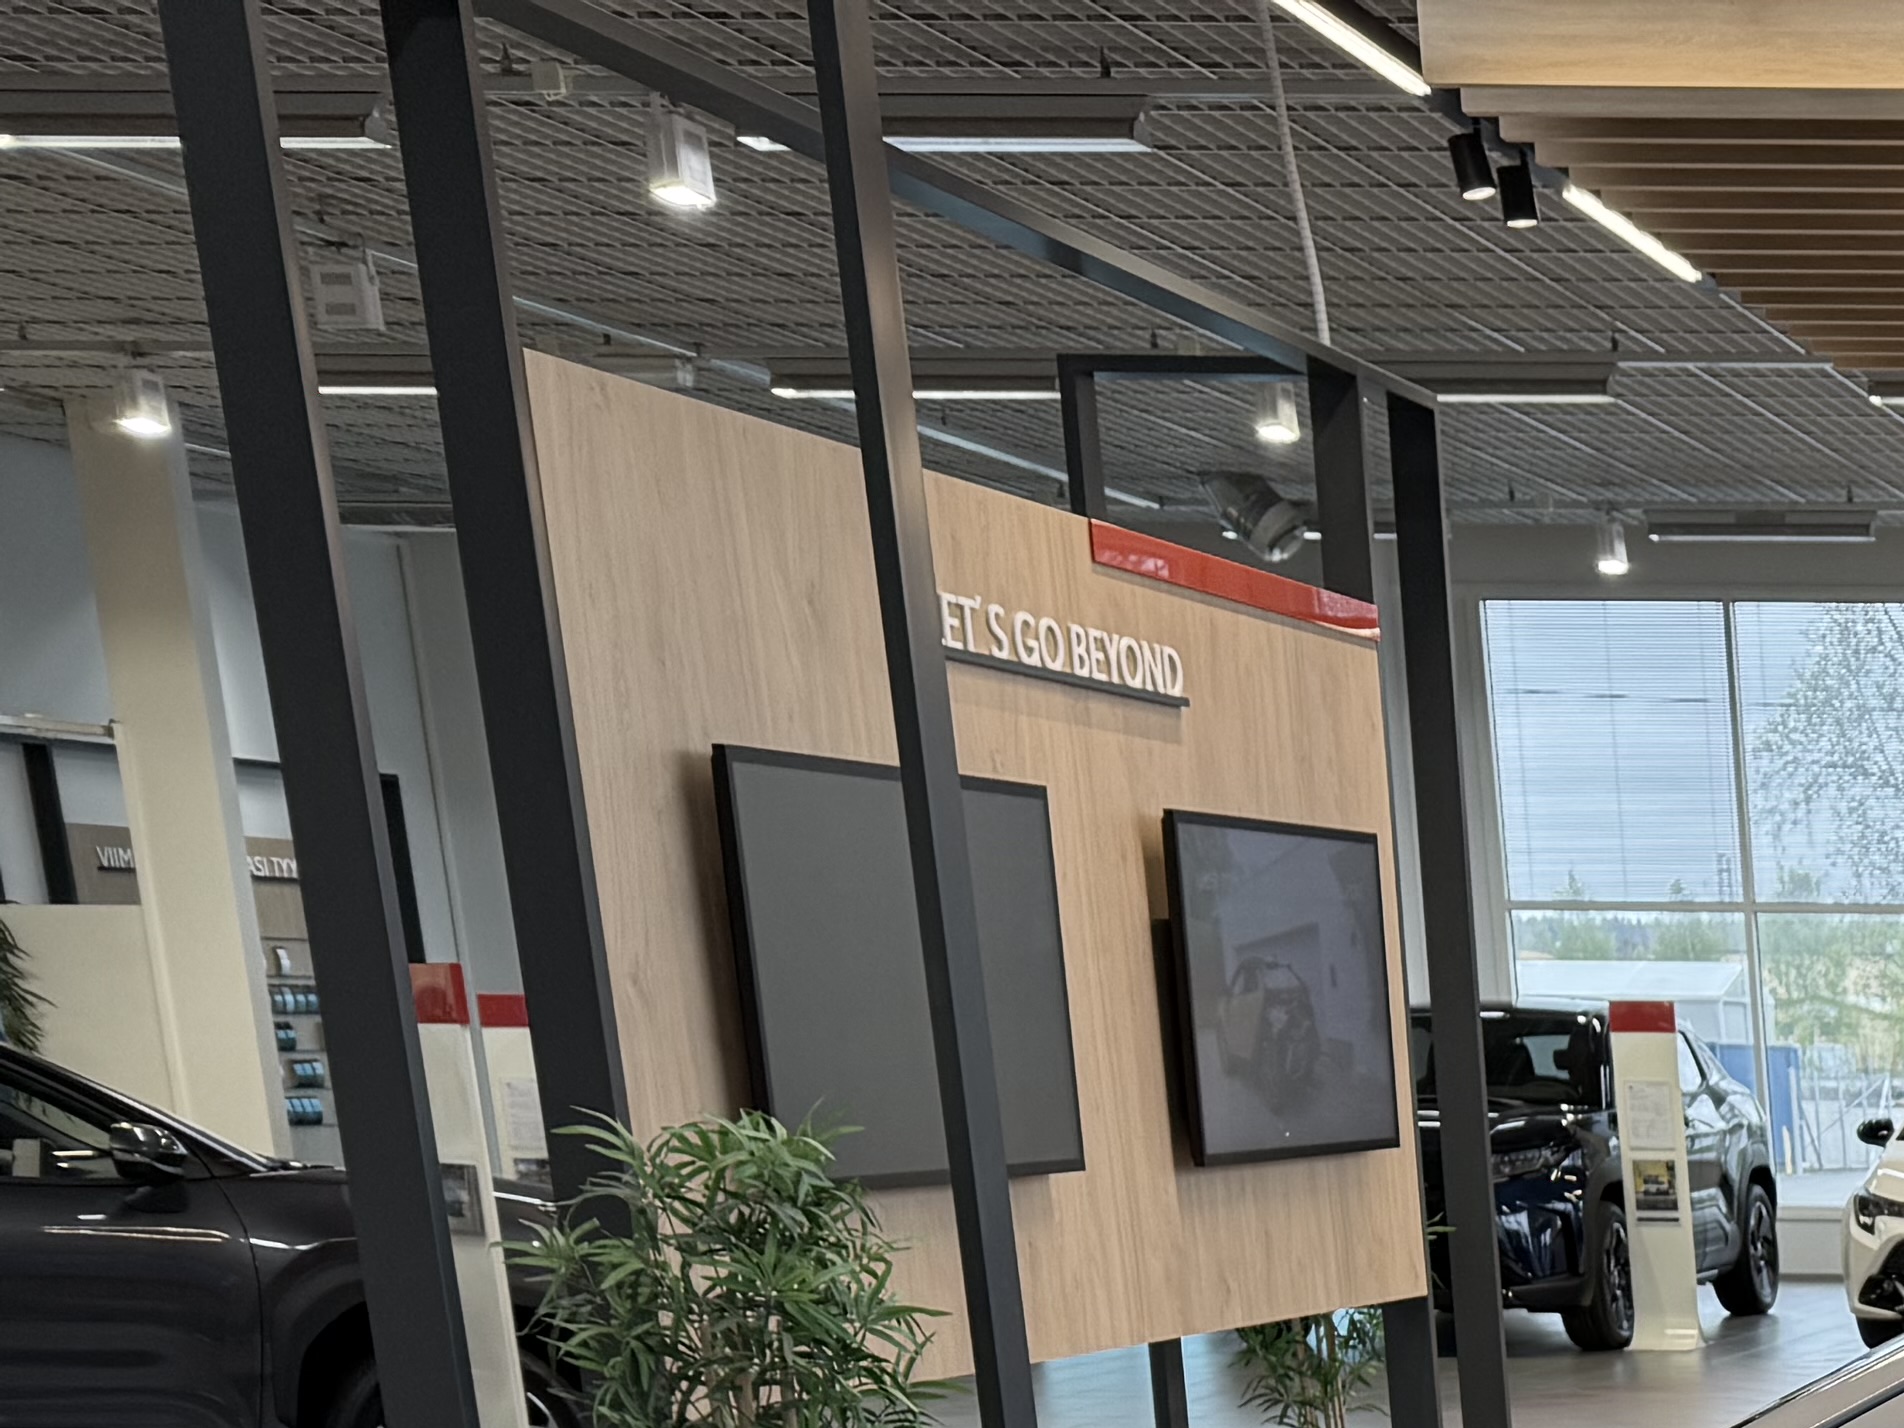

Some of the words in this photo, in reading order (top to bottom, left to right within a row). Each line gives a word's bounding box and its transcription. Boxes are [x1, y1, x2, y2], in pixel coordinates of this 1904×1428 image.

[940, 592, 1010, 660] ET'S
[1013, 611, 1065, 672] GO
[1068, 622, 1184, 697] BEYOND
